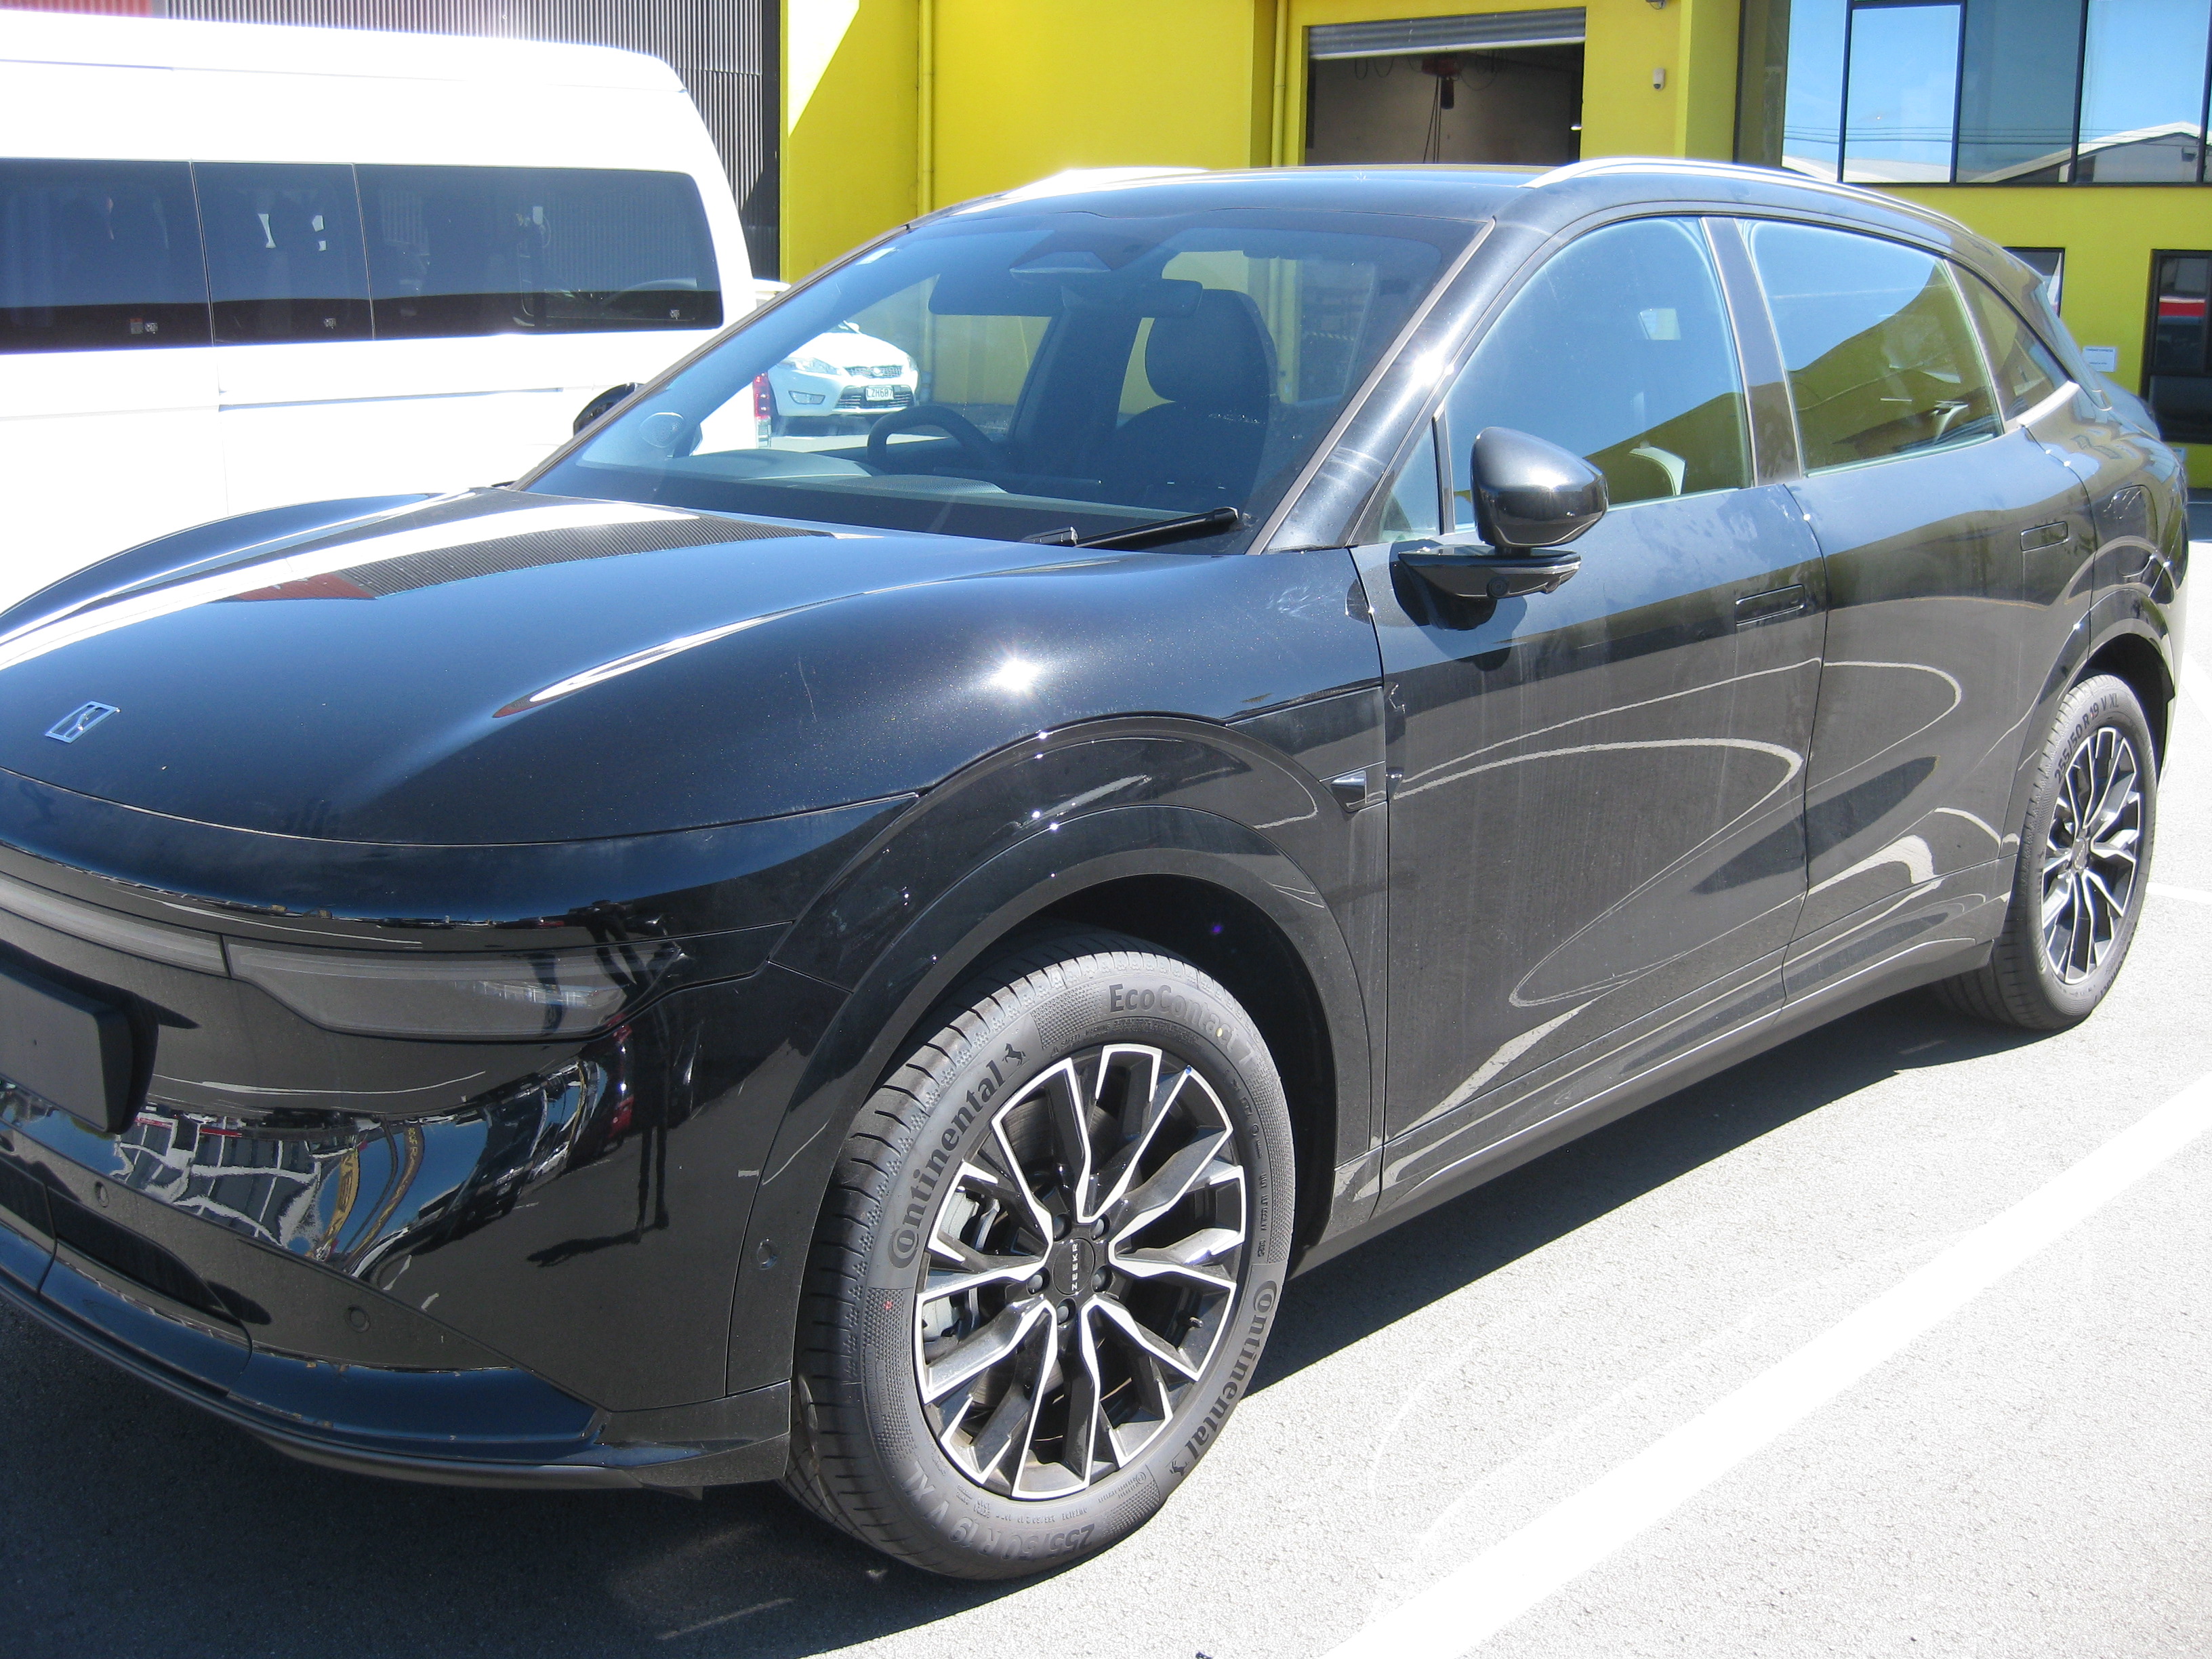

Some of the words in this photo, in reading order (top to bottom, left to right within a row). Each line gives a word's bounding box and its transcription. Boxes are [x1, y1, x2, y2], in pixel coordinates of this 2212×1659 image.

[2054, 723, 2083, 784] 255/50
[2082, 713, 2090, 729] R
[2089, 702, 2099, 720] 19
[2101, 695, 2107, 711] V
[2109, 693, 2118, 708] XL
[1109, 983, 1239, 1053] EcoContact
[1239, 1040, 1254, 1066] 7
[888, 1059, 1006, 1269] Continental
[1185, 1280, 1277, 1460] Continental
[900, 1460, 937, 1507] XL
[949, 1517, 980, 1548] 19
[978, 1528, 1002, 1556] R
[1000, 1523, 1095, 1559] 255/50
